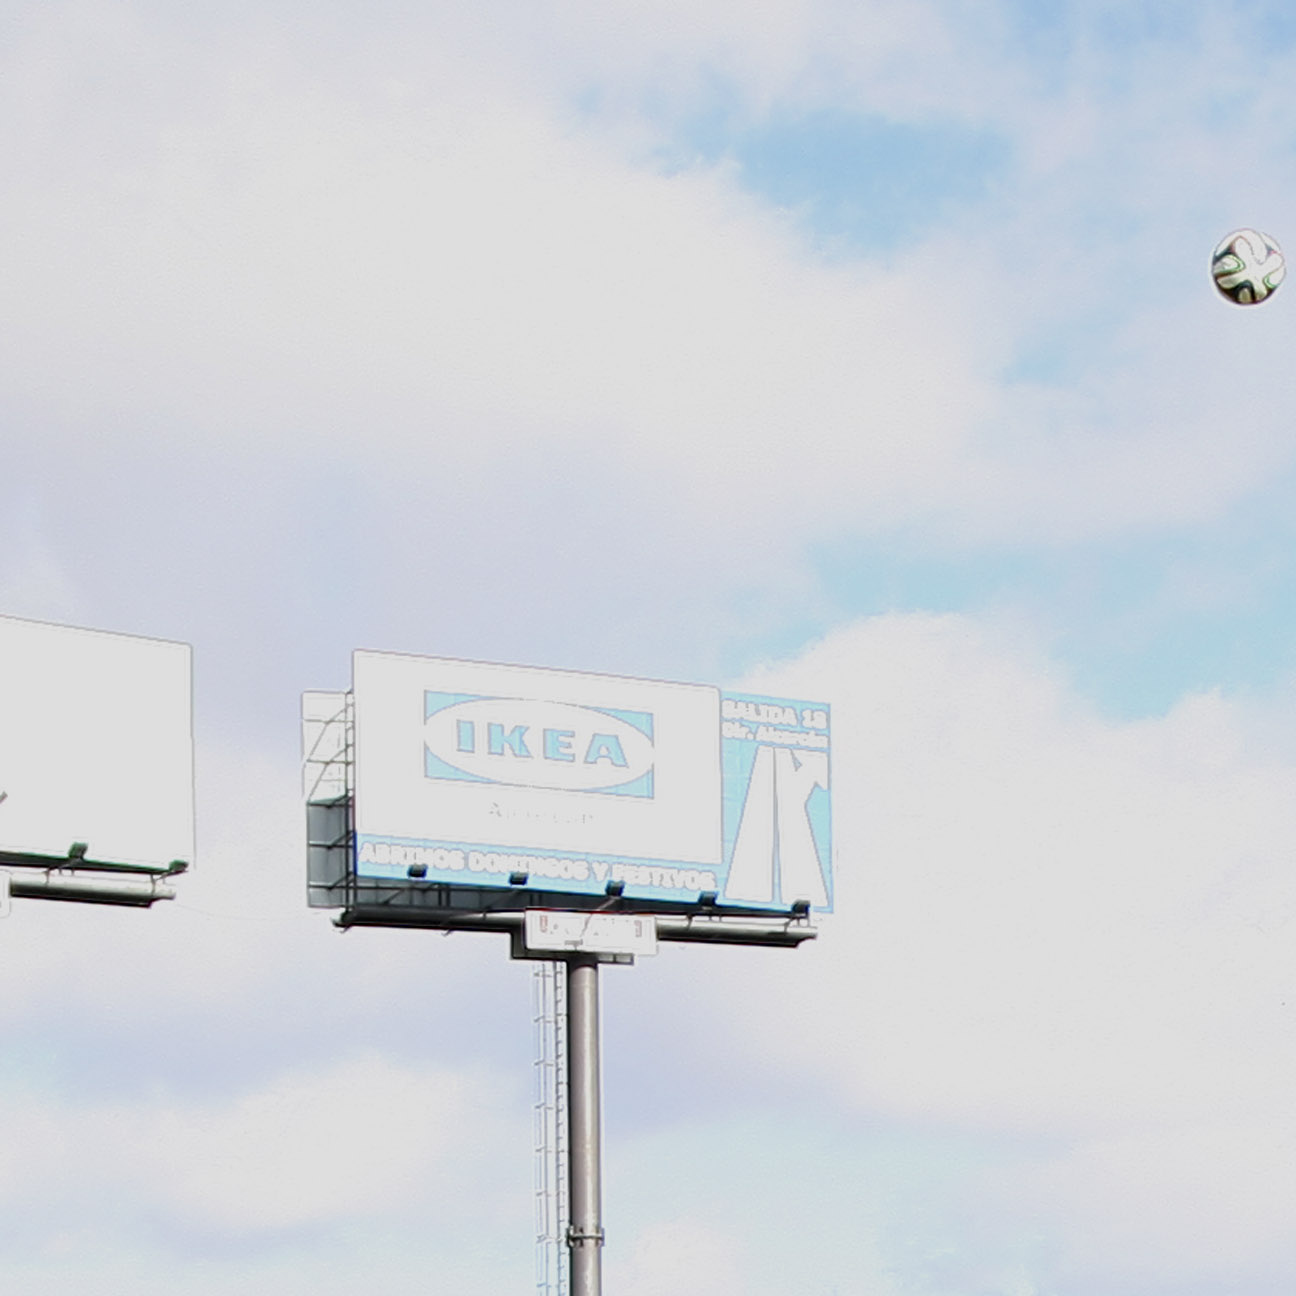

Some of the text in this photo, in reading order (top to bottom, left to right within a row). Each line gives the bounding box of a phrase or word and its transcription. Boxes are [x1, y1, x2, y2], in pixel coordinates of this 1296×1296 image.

[456, 719, 629, 768] IKEA
[358, 842, 466, 871] ABRIMOS
[468, 850, 589, 881] DOMINGOS
